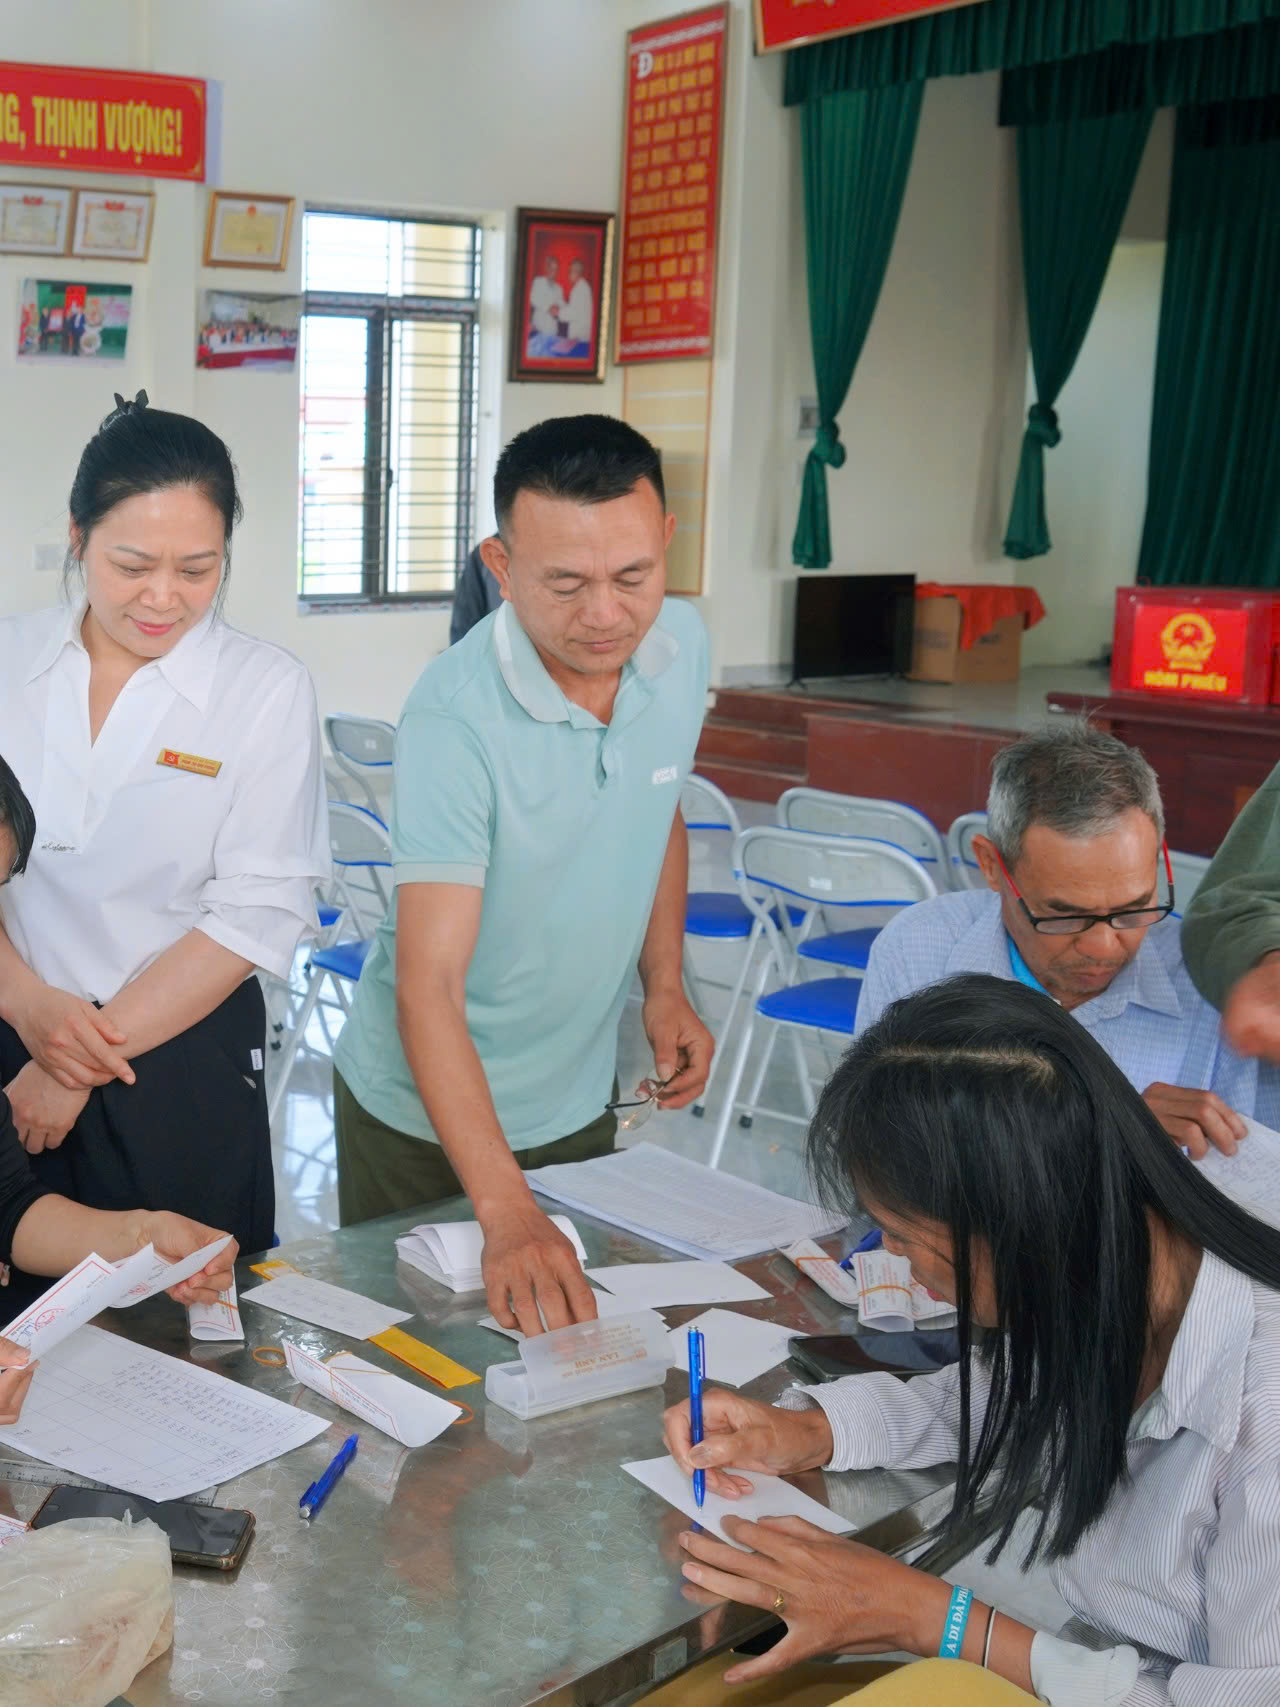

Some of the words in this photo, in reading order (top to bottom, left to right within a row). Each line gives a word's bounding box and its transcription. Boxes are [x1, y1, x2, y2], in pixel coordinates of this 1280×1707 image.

[32, 96, 98, 158] THỊNH
[104, 100, 182, 163] VƯỢNG!
[958, 1587, 969, 1604] PH
[949, 1625, 960, 1641] DI
[946, 1642, 957, 1654] A
